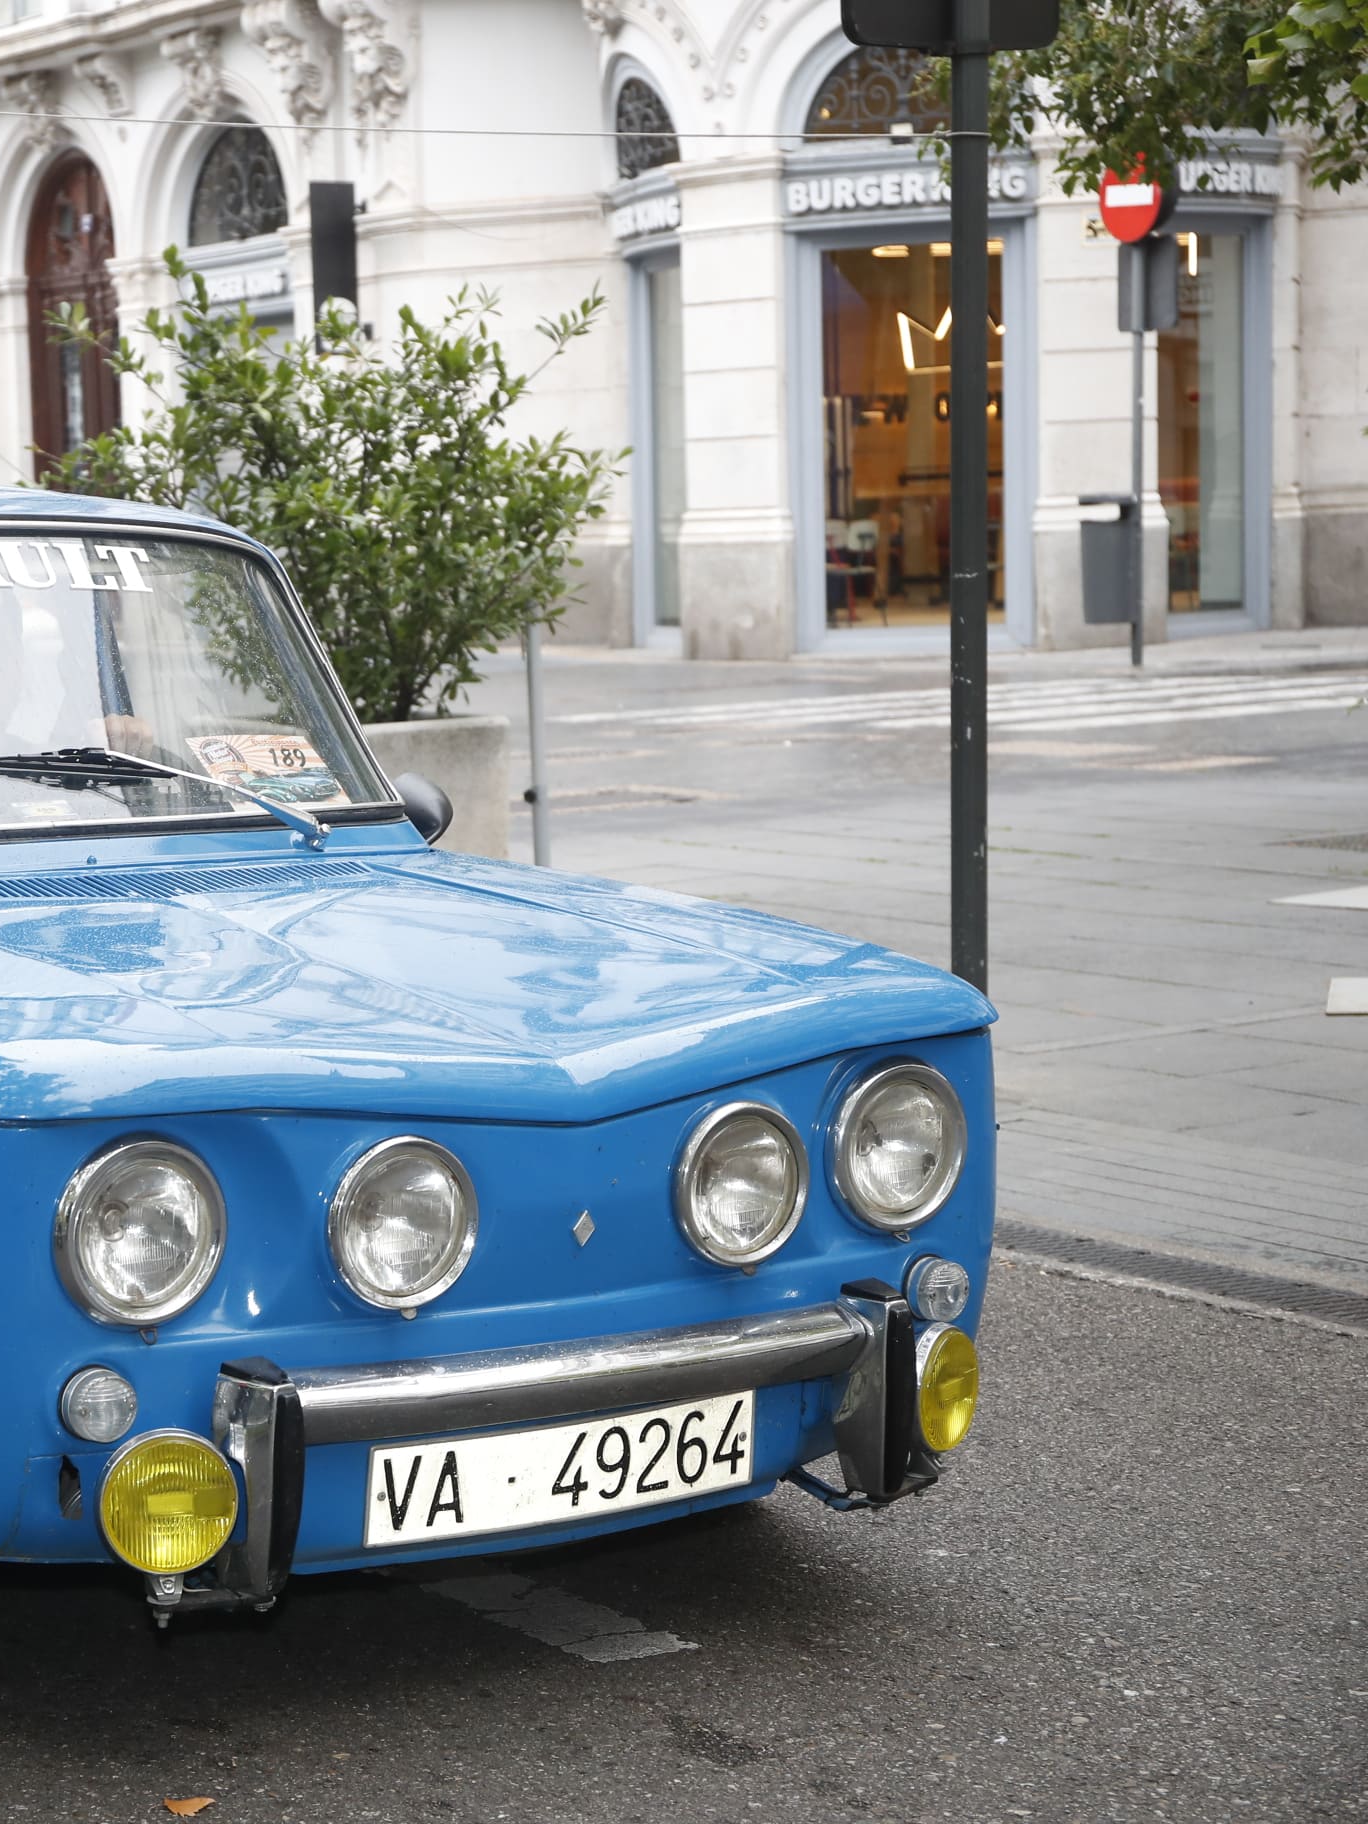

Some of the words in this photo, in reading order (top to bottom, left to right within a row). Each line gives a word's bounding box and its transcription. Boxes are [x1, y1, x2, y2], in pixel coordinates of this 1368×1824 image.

[787, 172, 925, 215] BURGER
[932, 166, 1027, 203] KG
[1178, 161, 1254, 193] URGER
[269, 747, 307, 768] 189
[383, 1450, 464, 1531] VA
[551, 1399, 745, 1507] 49264
